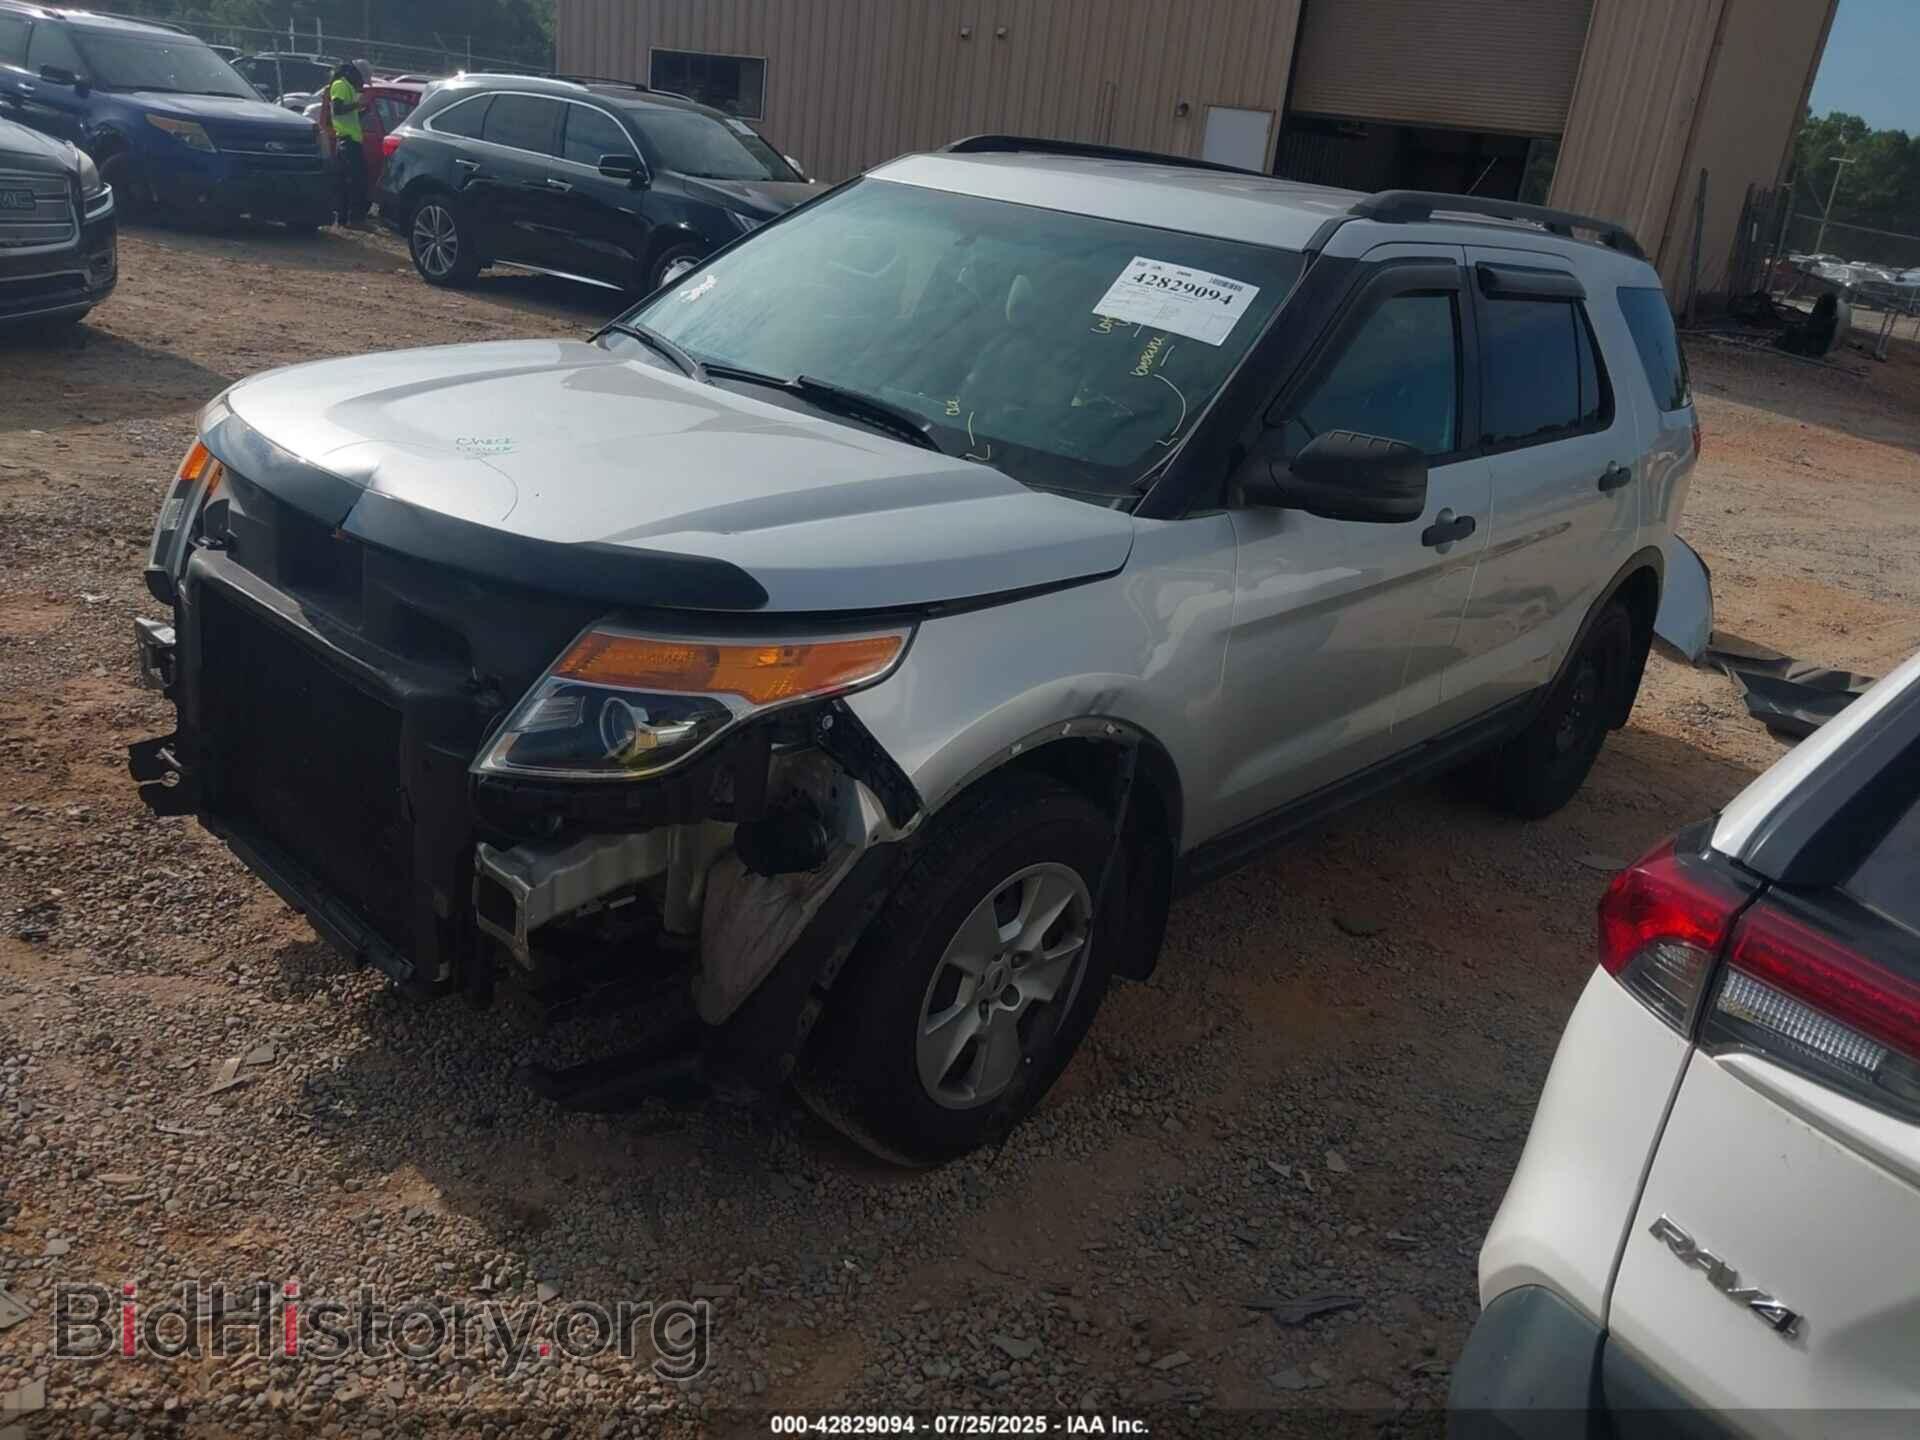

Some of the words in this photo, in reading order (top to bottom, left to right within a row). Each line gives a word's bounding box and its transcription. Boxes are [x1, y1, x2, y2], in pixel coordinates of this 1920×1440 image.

[0, 191, 32, 209] MC
[1132, 271, 1235, 306] 42829094
[1648, 1213, 1801, 1337] RAV4
